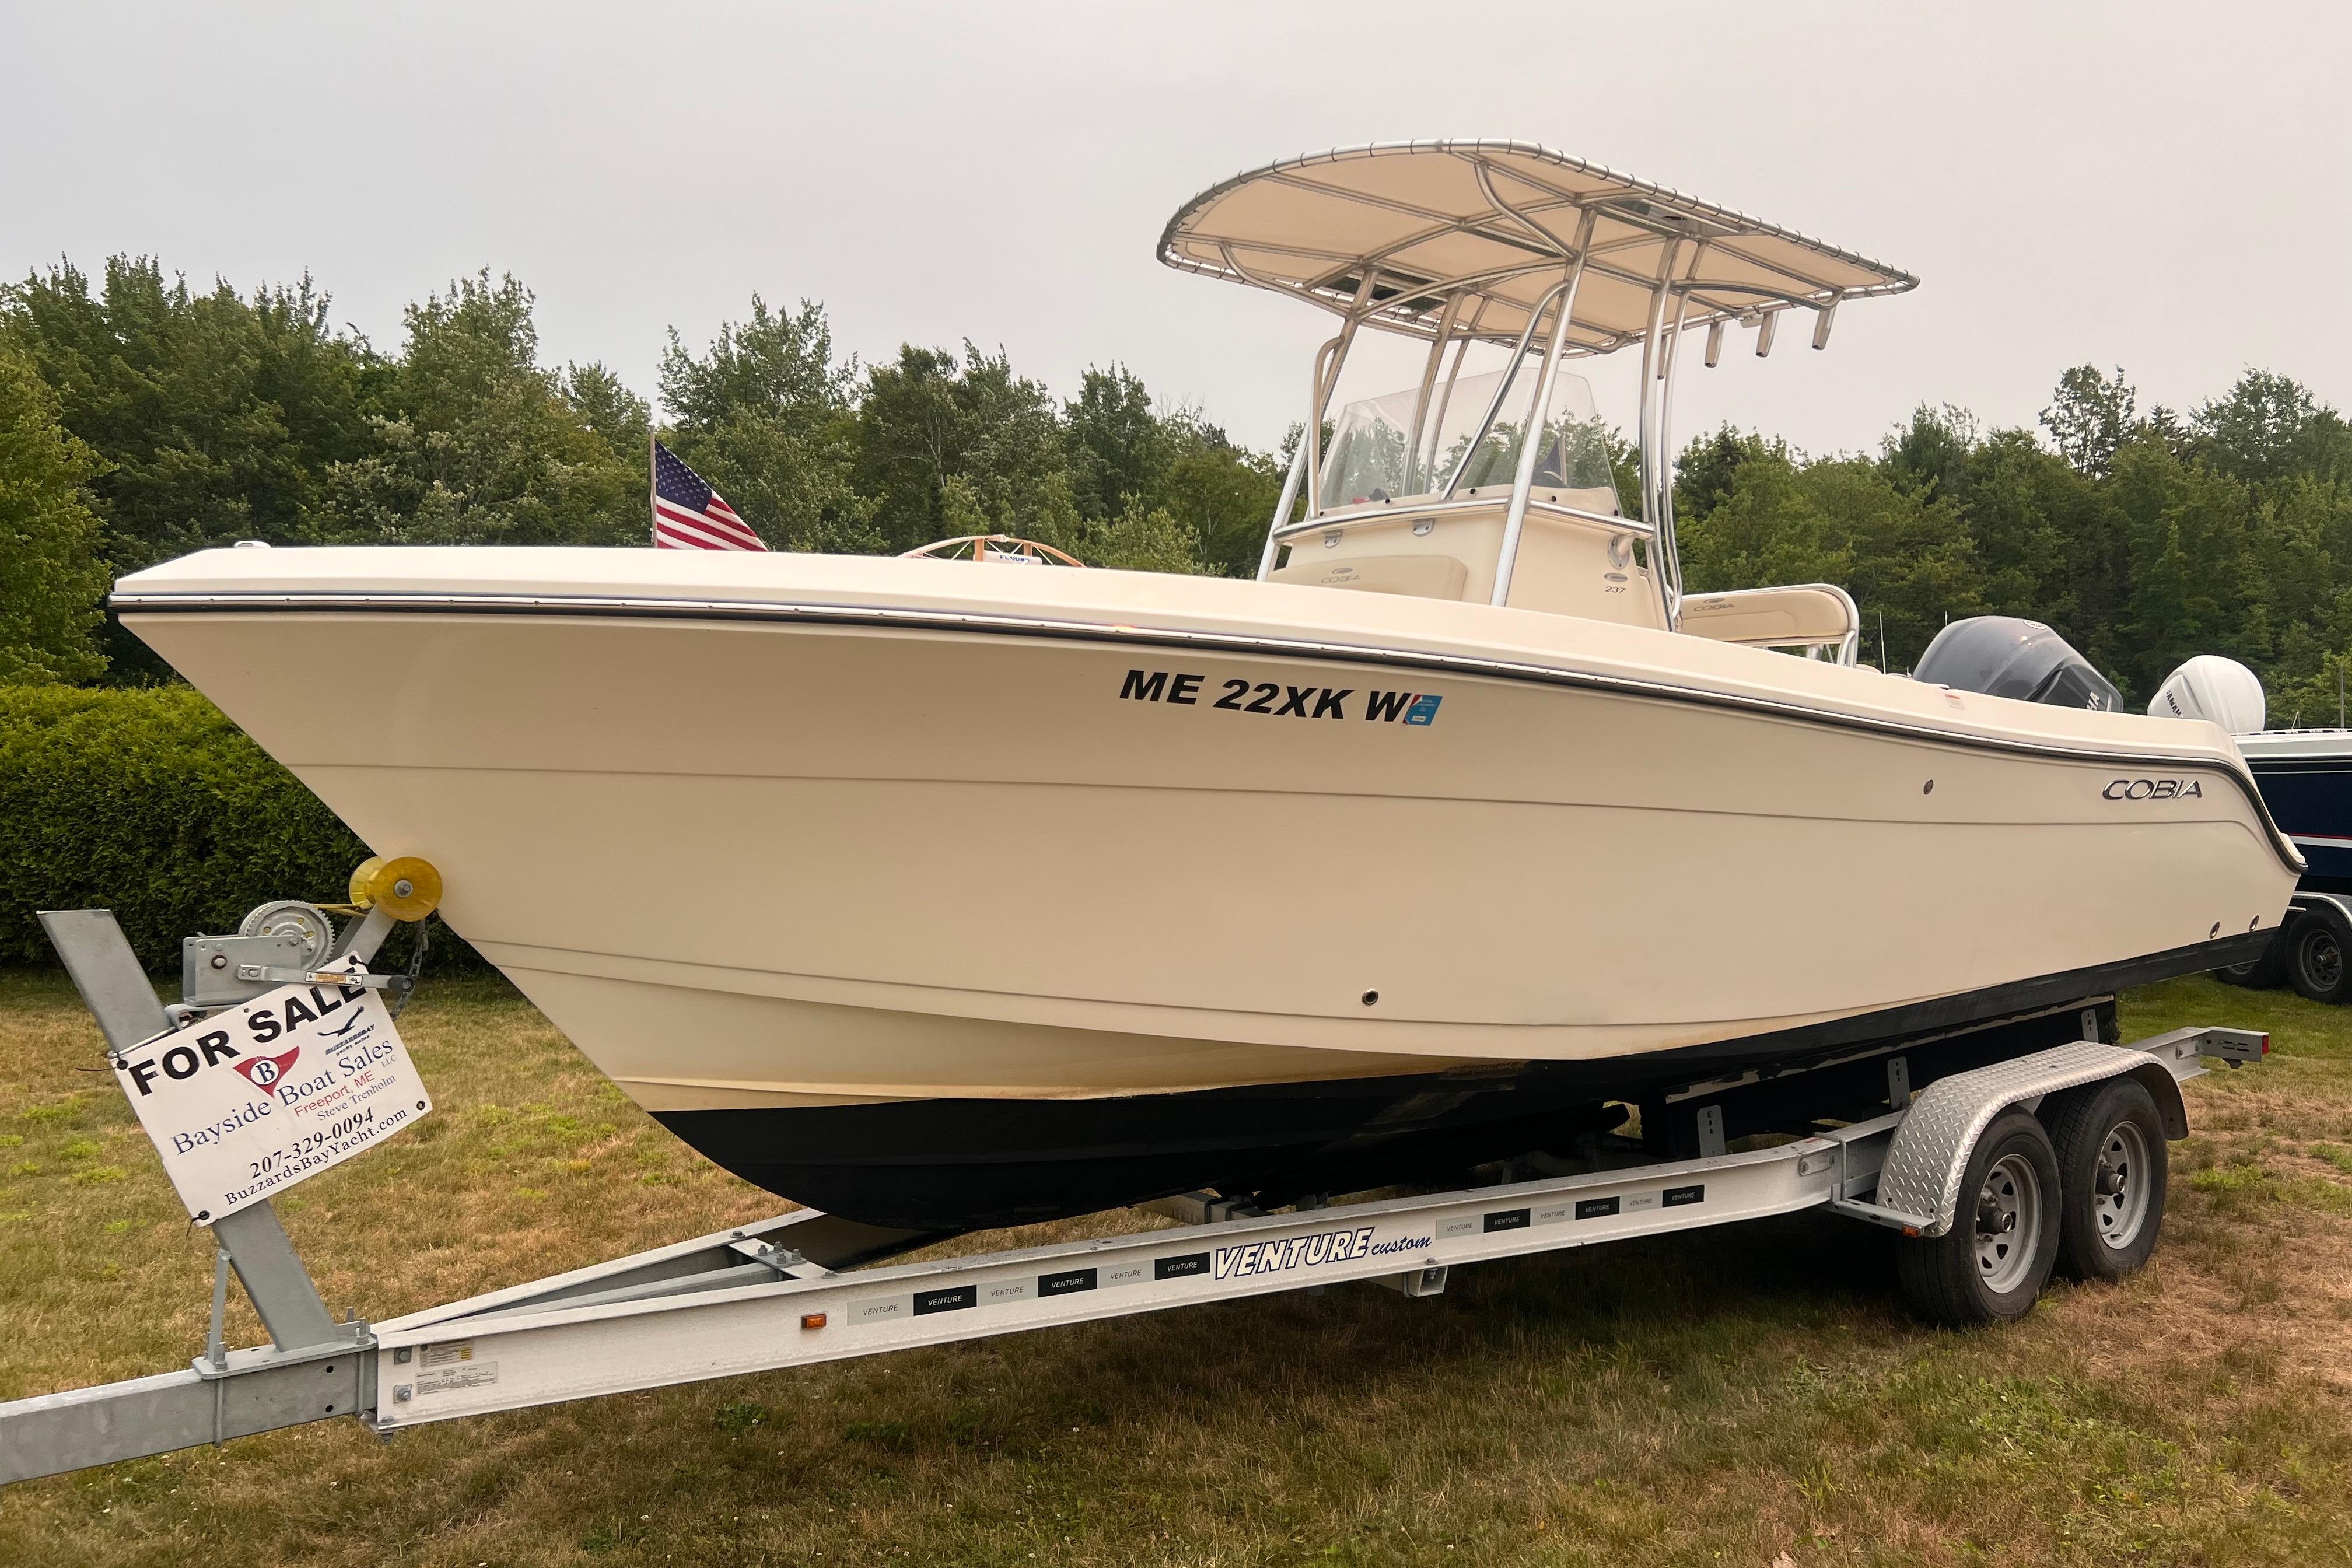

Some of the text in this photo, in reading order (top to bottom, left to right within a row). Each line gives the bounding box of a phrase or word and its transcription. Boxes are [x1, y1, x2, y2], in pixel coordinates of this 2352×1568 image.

[1119, 670, 1205, 705] ME
[1213, 679, 1354, 719] 22XK
[1365, 691, 1412, 722] W
[2166, 688, 2182, 718] YAMAH
[2102, 779, 2202, 800] COBIA
[128, 967, 367, 1096] FOR SALE
[326, 1024, 375, 1055] BUZZARDSBAY
[336, 1035, 370, 1056] yacht sales
[382, 1055, 397, 1068] LLC
[256, 1062, 276, 1084] B
[170, 1040, 393, 1155] Bayside Boat Sales
[294, 1070, 374, 1117] Freeport, ME
[317, 1075, 396, 1121] Steve Trenholm
[250, 1107, 374, 1180] 207-329-0094
[225, 1110, 408, 1205] BuzzardsBayYacht.com
[1629, 1198, 1653, 1206] VENTURE
[1671, 1192, 1695, 1200] VENTURE
[1540, 1210, 1566, 1219] VENTURE
[1585, 1203, 1610, 1213] VENTURE
[1447, 1223, 1474, 1231] VENTURE
[1494, 1216, 1520, 1225] VENTURE
[1215, 1226, 1432, 1280] VENTURE custom
[1111, 1269, 1142, 1280] VENTURE
[1167, 1261, 1198, 1272] VENTURE
[991, 1286, 1024, 1297] VENTURE
[1052, 1278, 1084, 1289] VENTURE
[863, 1304, 899, 1315] VENTURE
[928, 1295, 963, 1307] VENTURE
